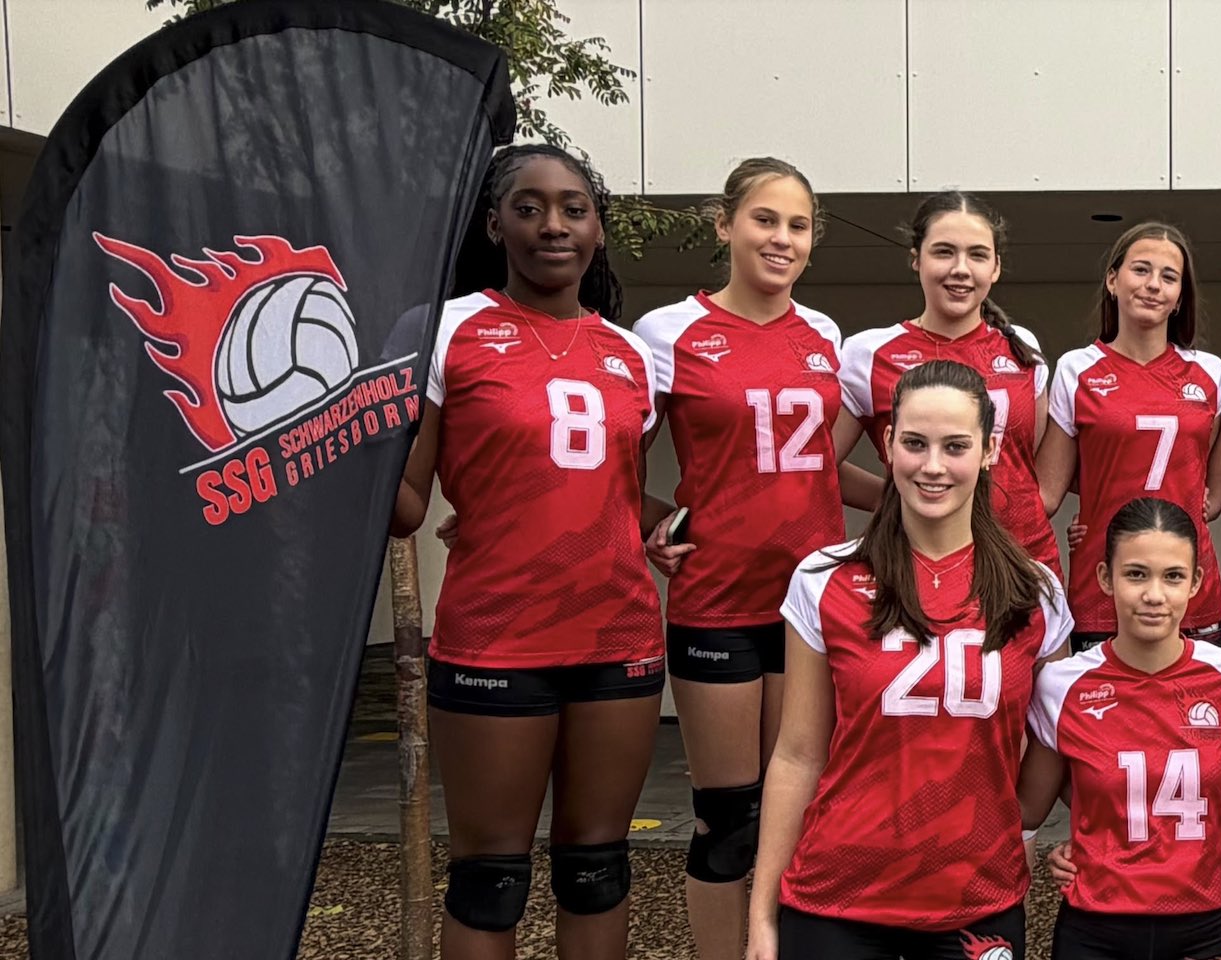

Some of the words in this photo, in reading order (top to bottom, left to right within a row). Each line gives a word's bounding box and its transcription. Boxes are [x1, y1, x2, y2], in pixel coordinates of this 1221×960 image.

[477, 327, 512, 338] Philipp
[278, 367, 418, 459] SCHWARZENHOLZ
[285, 395, 420, 487] GRIESBORN
[546, 377, 607, 471] 8
[744, 387, 825, 474] 12
[1135, 414, 1179, 491] 7
[196, 446, 279, 526] SSG
[454, 672, 509, 690] Kempa
[687, 645, 730, 661] Kempa
[881, 626, 1002, 720] 20
[1079, 688, 1110, 702] Philipp
[1117, 748, 1209, 842] 14
